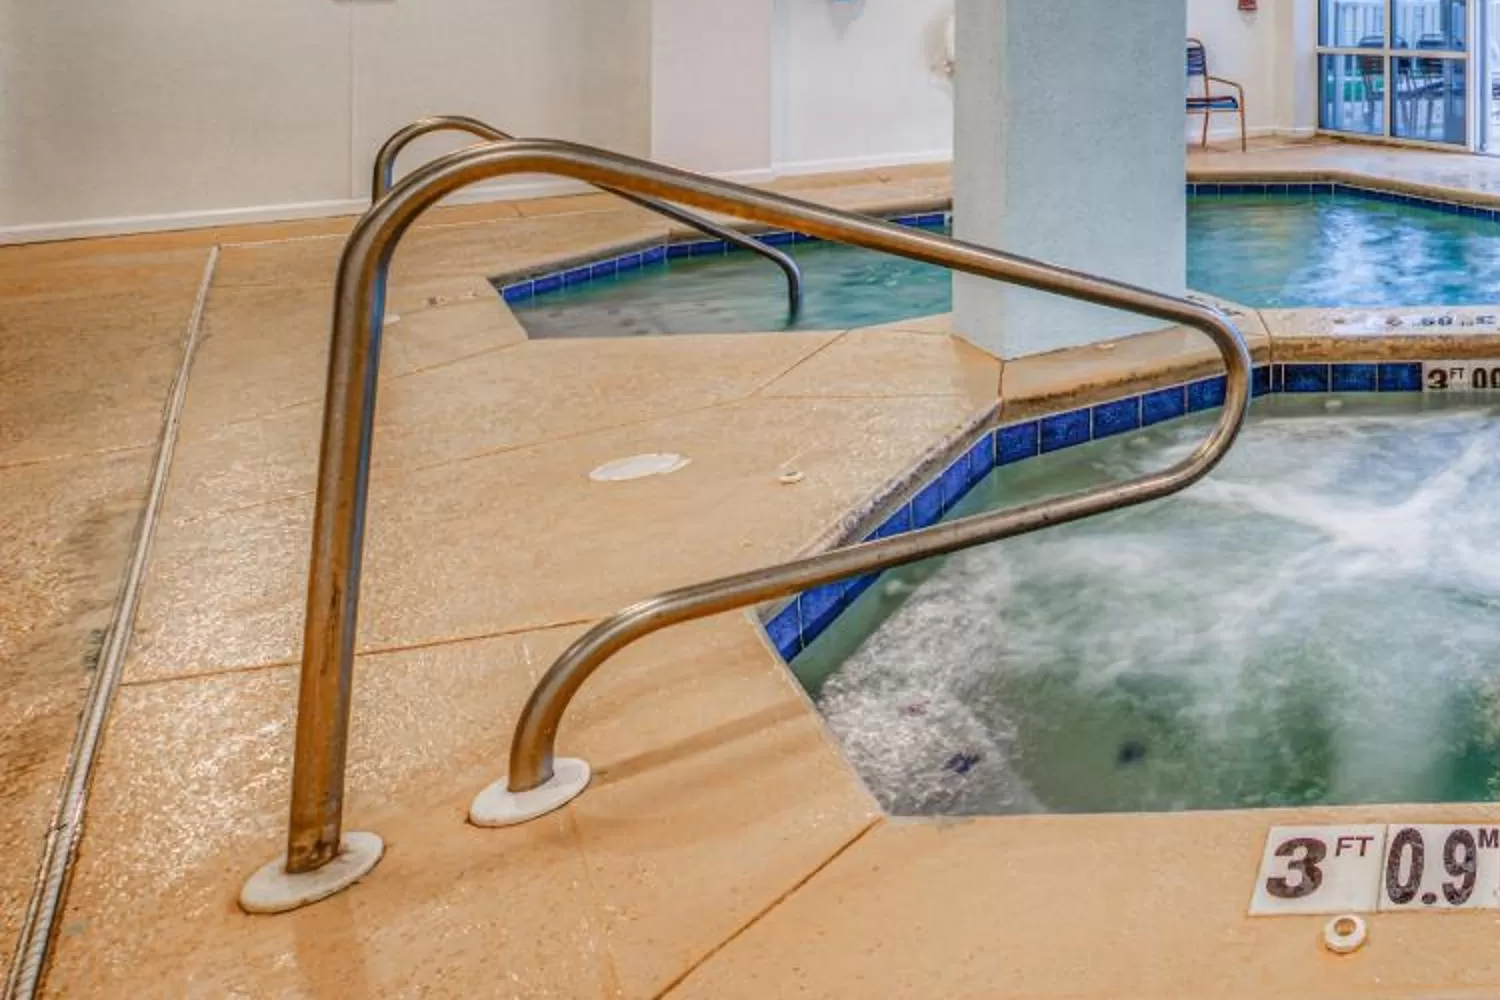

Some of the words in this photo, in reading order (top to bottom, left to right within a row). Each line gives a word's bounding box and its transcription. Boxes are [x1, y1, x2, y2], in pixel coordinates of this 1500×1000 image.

[1427, 368, 1449, 389] 3
[1265, 837, 1327, 899] 3
[1335, 835, 1375, 858] FT
[1385, 827, 1477, 906] 0.9
